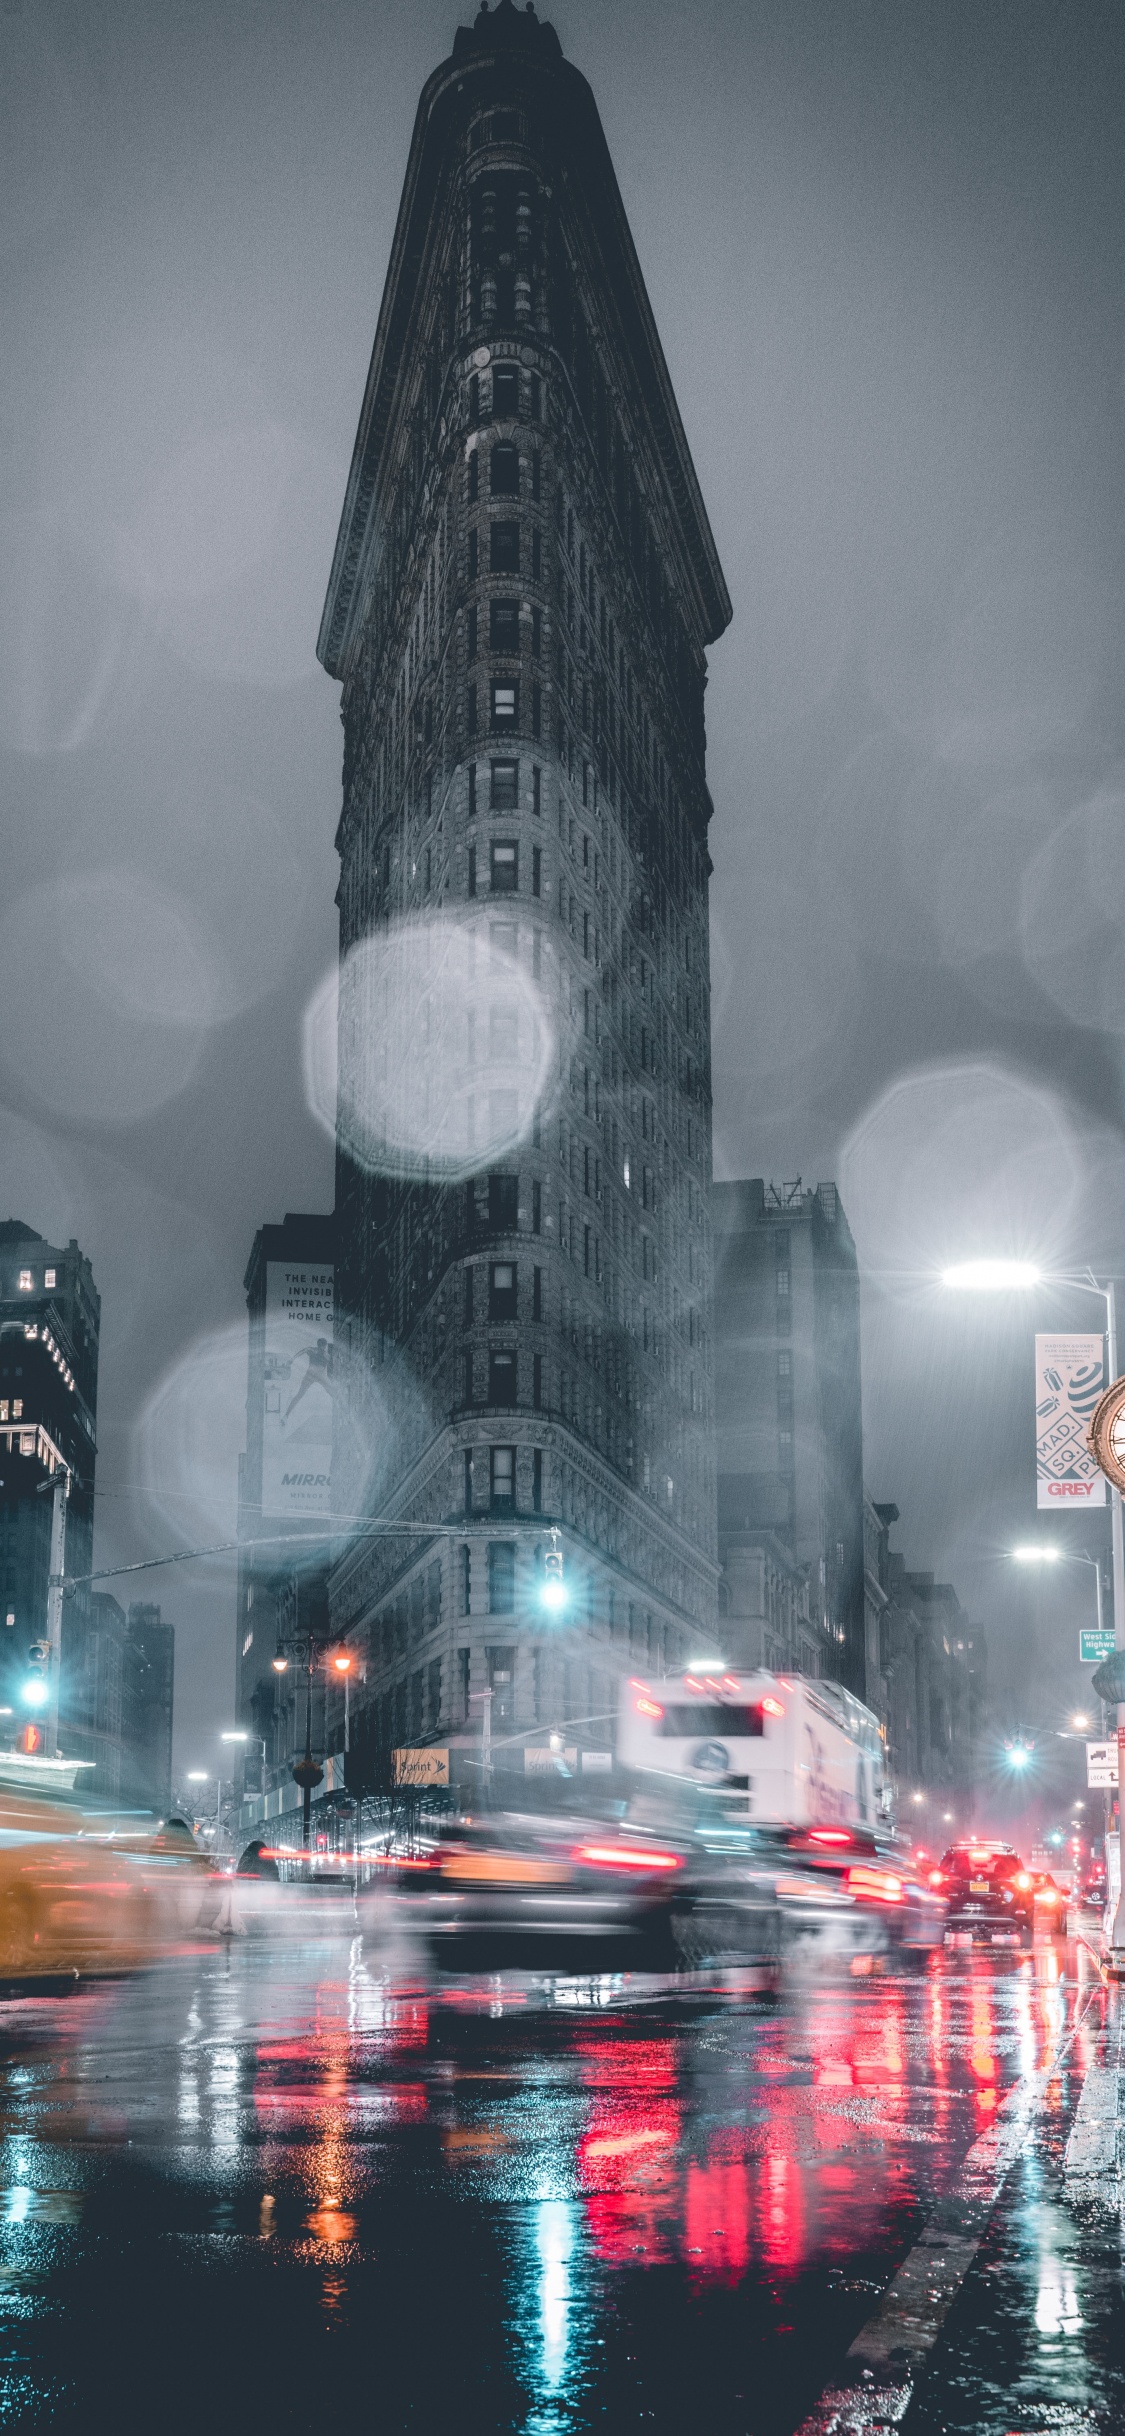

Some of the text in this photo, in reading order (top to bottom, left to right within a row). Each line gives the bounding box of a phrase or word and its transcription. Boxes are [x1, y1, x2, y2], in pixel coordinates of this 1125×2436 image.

[285, 1274, 306, 1282] THE
[289, 1312, 321, 1321] HOME
[1037, 1425, 1075, 1457] MAD.
[1053, 1450, 1080, 1471] SQ.
[1048, 1483, 1094, 1496] GREY
[402, 1762, 431, 1775] Sprint
[529, 1761, 558, 1774] Sprin
